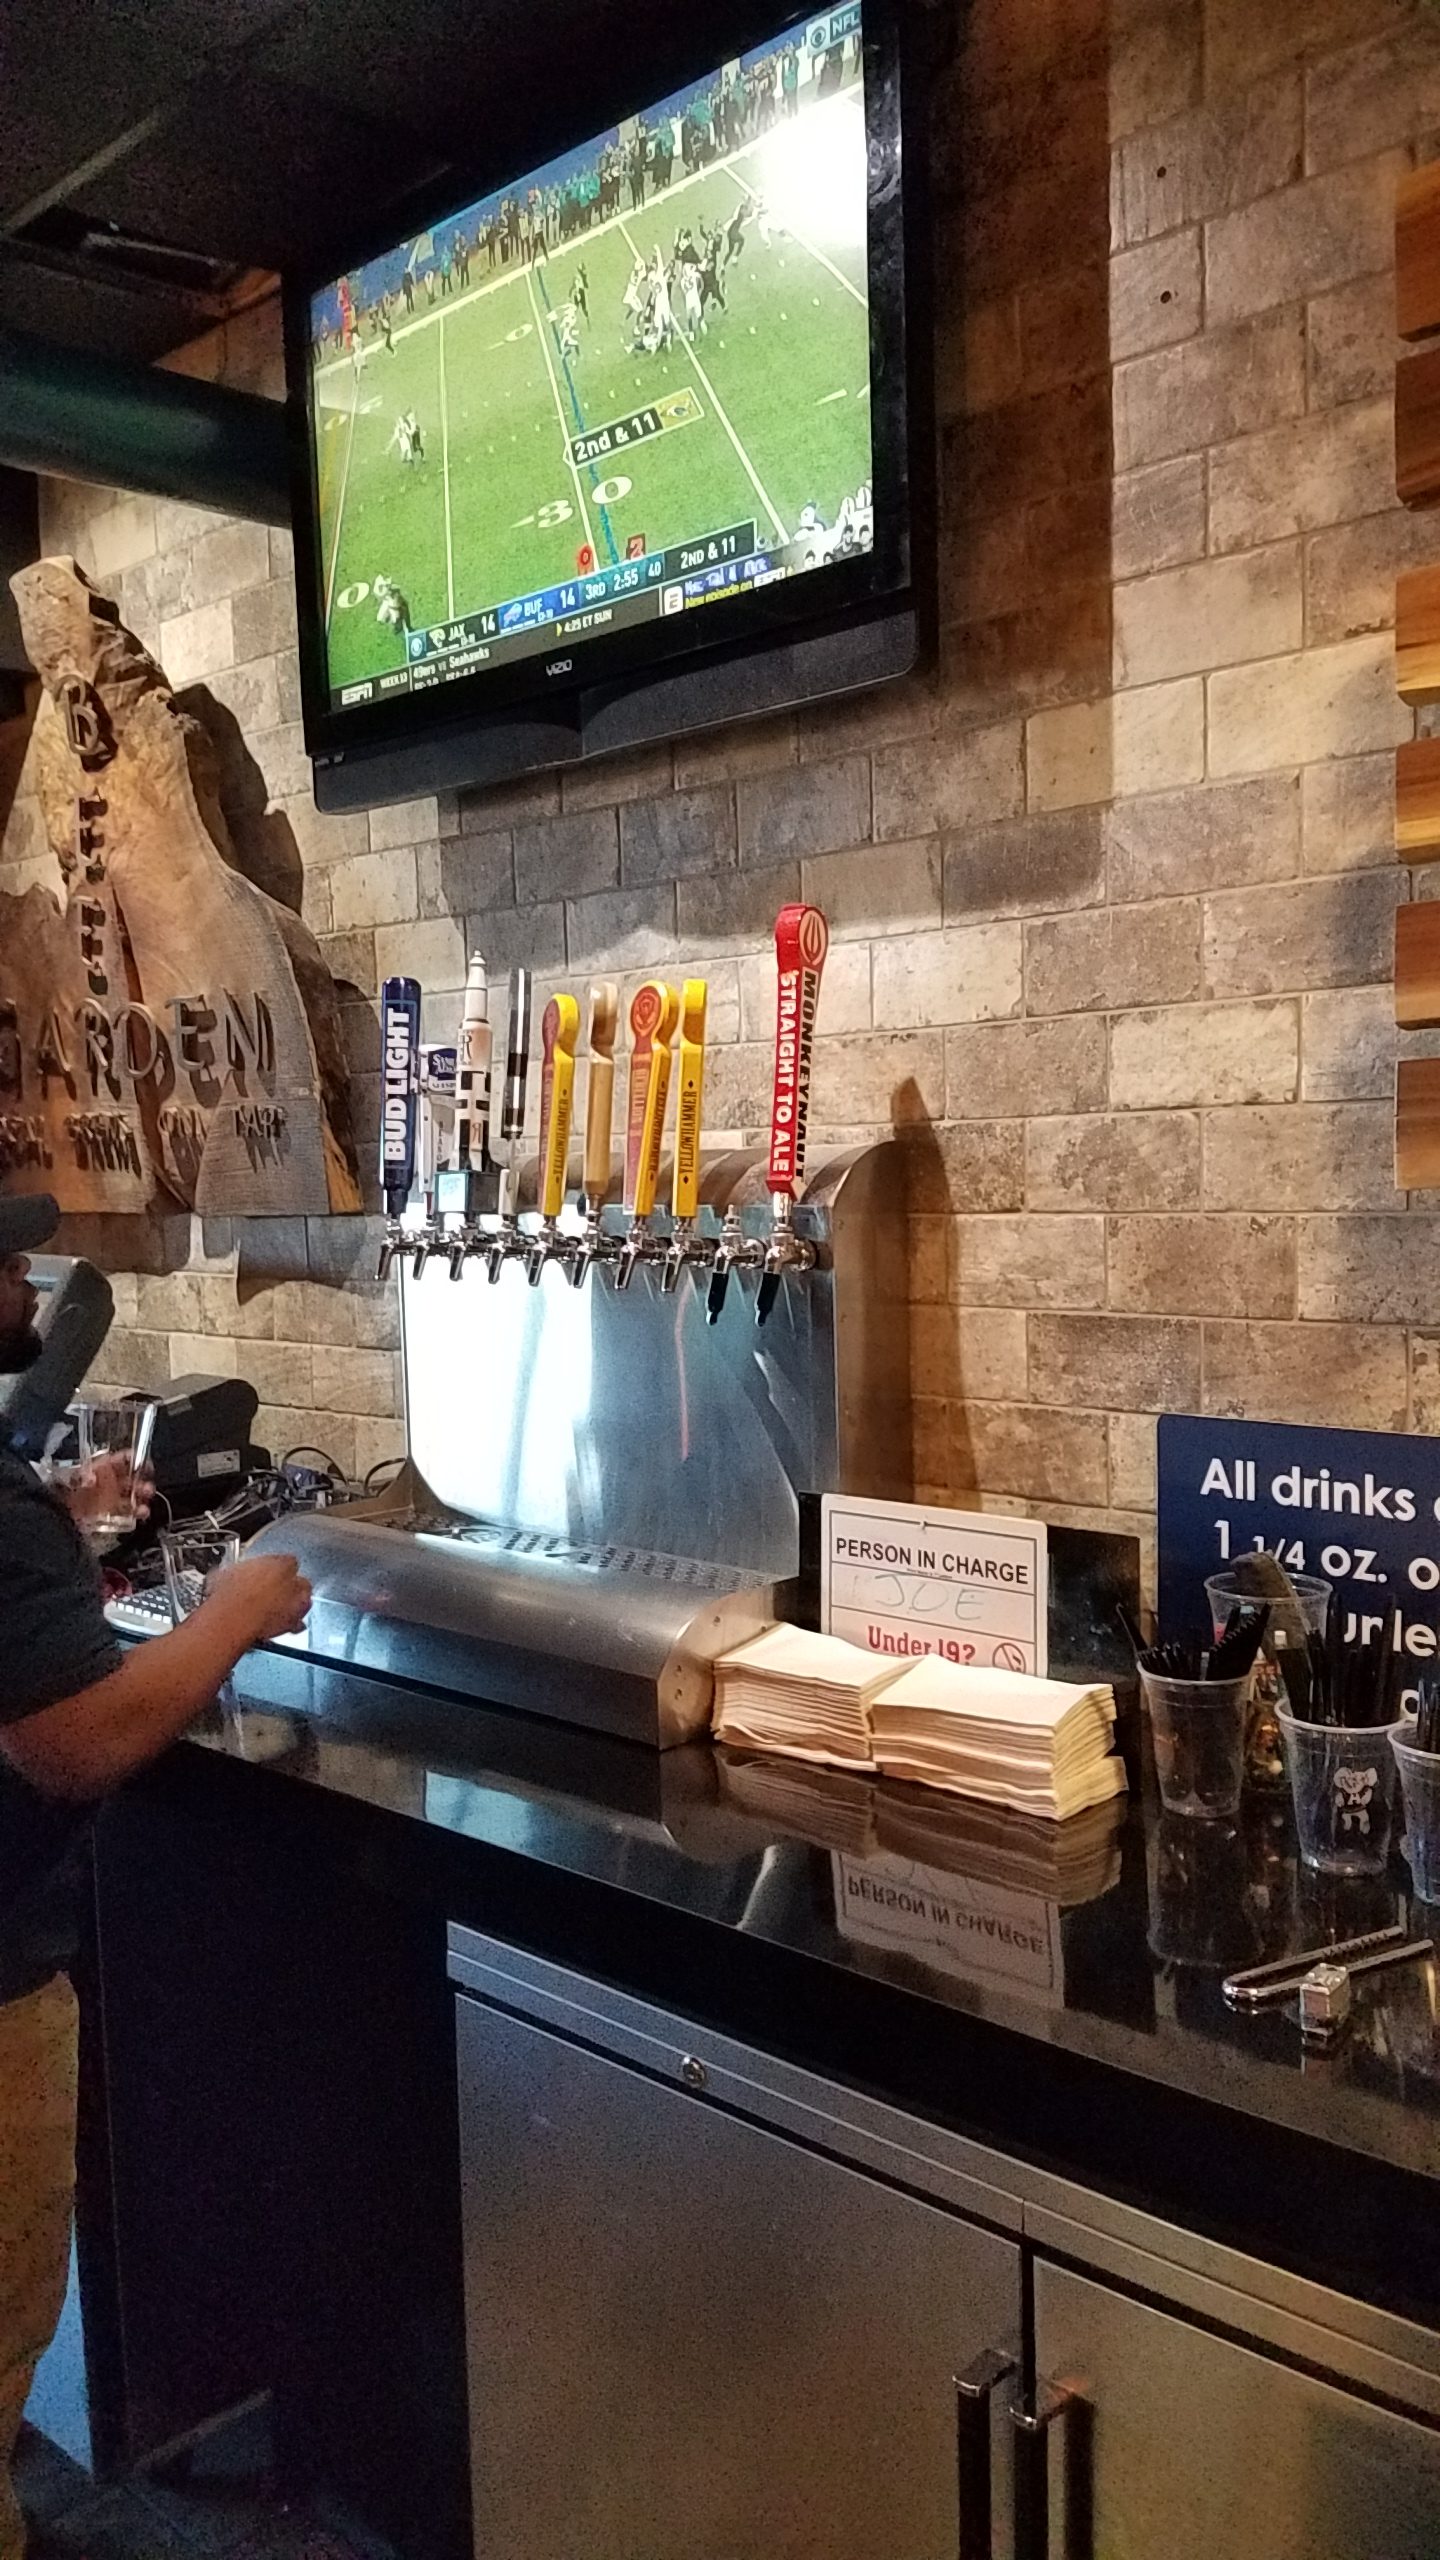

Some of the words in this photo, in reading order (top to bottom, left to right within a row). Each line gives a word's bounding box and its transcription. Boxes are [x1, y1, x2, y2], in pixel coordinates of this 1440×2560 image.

[832, 13, 860, 36] NFL
[574, 432, 611, 461] 2nd
[615, 427, 629, 444] &
[631, 412, 656, 436] 11
[680, 550, 704, 570] 2ND
[708, 542, 718, 560] &
[721, 535, 736, 556] 11
[524, 598, 543, 617] BUF
[560, 587, 575, 609] 14
[585, 581, 606, 600] 3RD
[613, 568, 639, 592] 2:55
[448, 623, 466, 642] JAX
[481, 613, 495, 635] 14
[593, 609, 613, 626] SUN
[449, 647, 490, 669] Seahawks
[341, 682, 373, 705] ESPN
[380, 674, 400, 689] WEEK
[0, 984, 276, 1080] ARDEN
[778, 970, 799, 1088] STRAIGHT
[385, 1007, 411, 1097] LIGHT
[796, 970, 817, 1179] MONKEYNAUT
[776, 1091, 793, 1124] TO
[384, 1098, 407, 1162] BUD
[679, 1090, 698, 1175] YELLOWHAMMER
[772, 1128, 791, 1173] ALE
[1200, 1457, 1256, 1502] All
[1270, 1465, 1417, 1522] drinks
[1213, 1519, 1231, 1560] 1
[836, 1537, 912, 1566] PERSON
[917, 1549, 936, 1570] IN
[942, 1553, 1029, 1586] CHARGE
[873, 1573, 986, 1621] JOE
[867, 1625, 932, 1656] Under
